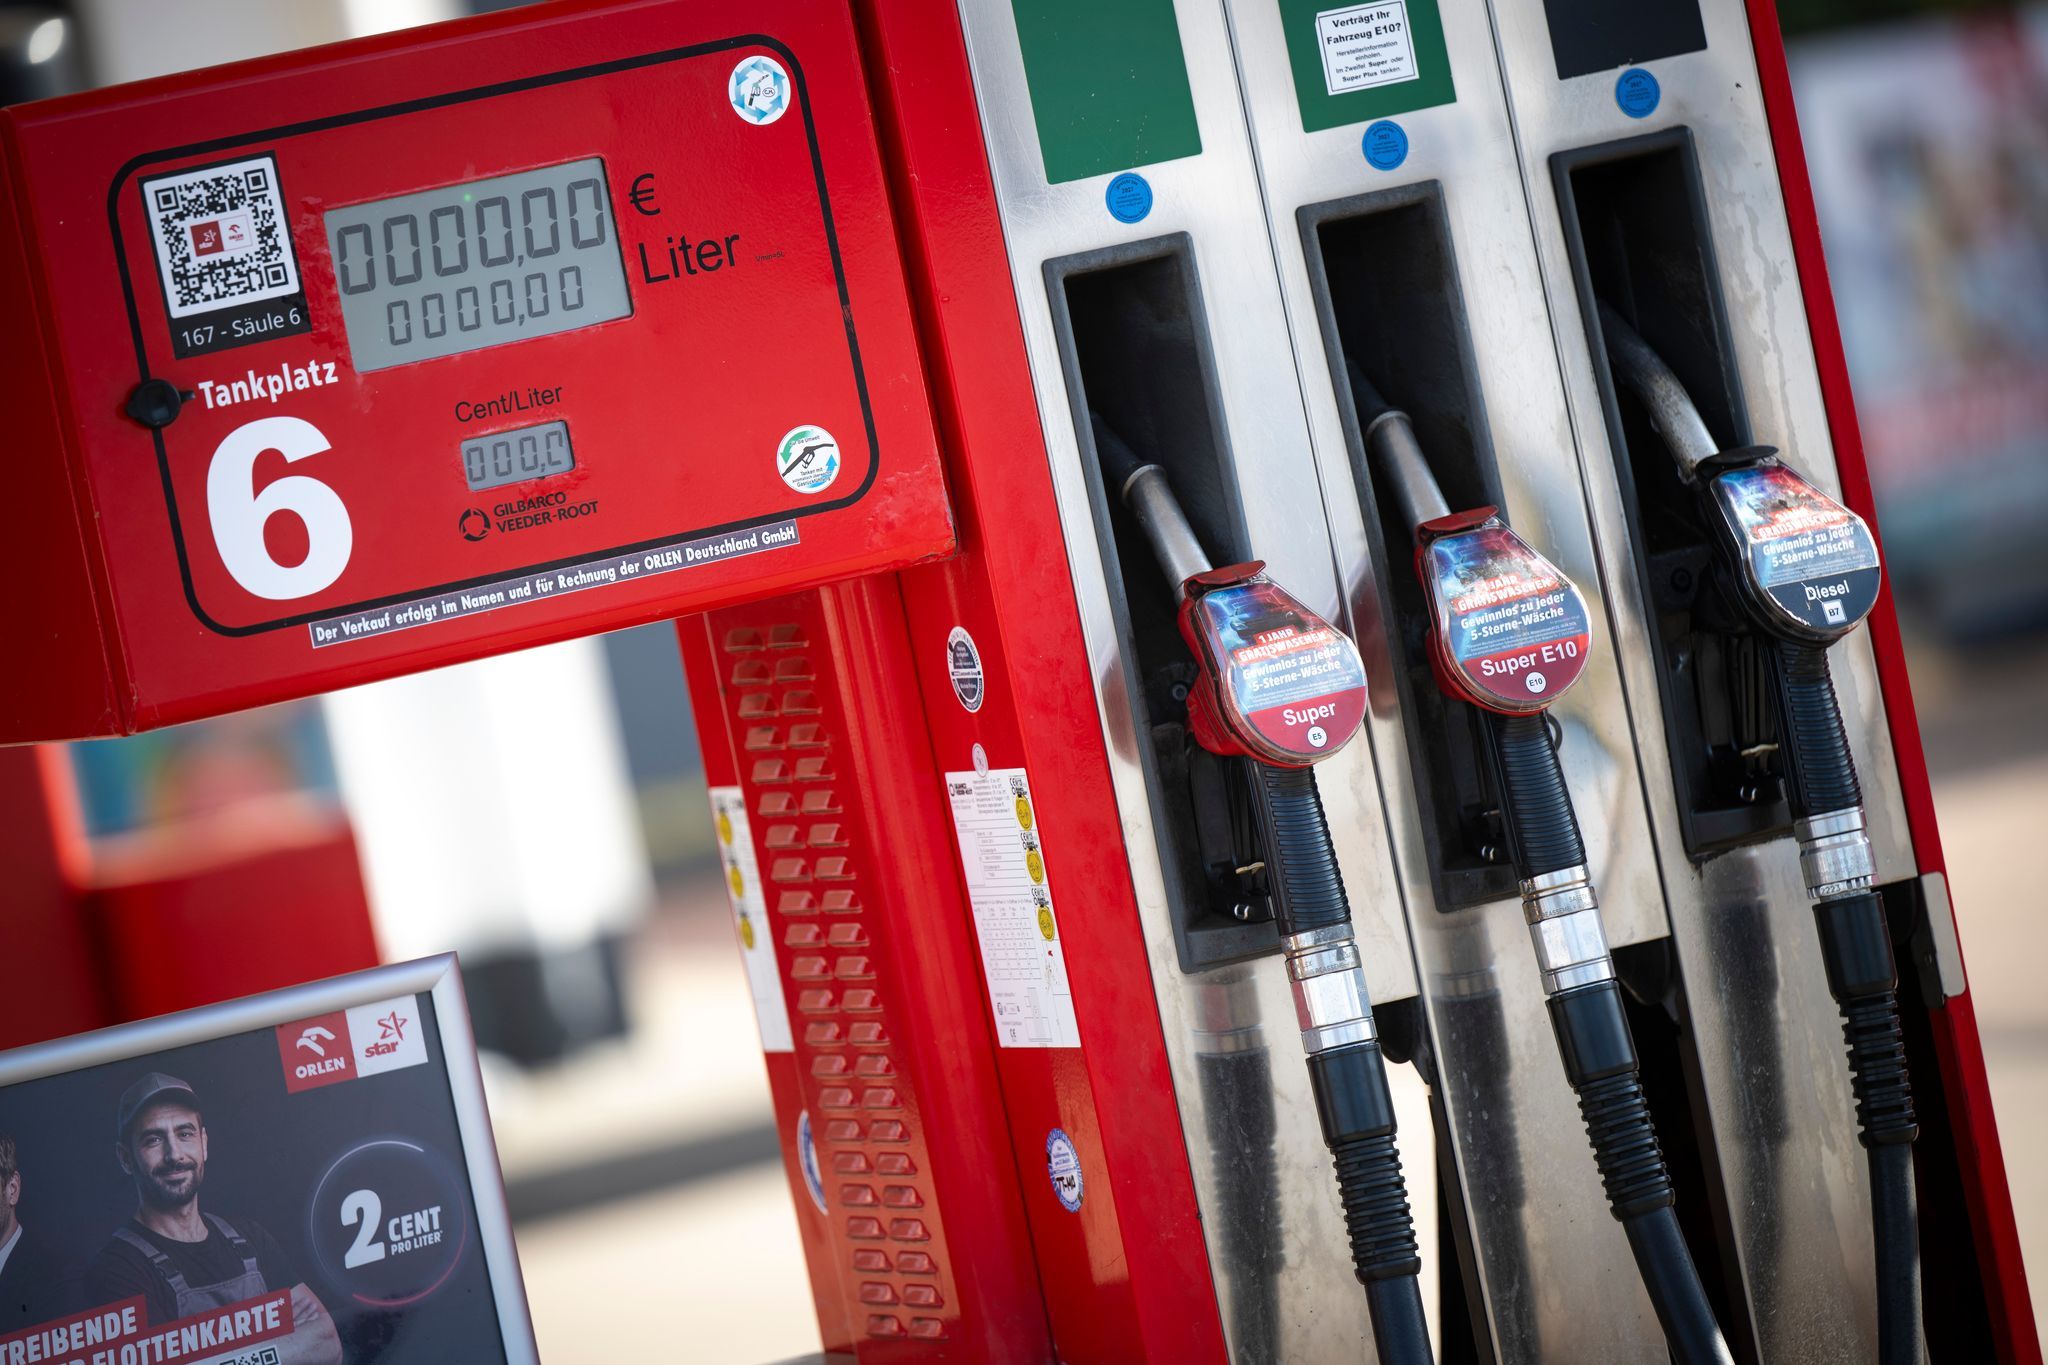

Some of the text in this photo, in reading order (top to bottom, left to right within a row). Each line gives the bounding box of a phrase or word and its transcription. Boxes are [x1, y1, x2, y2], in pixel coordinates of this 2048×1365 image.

[1327, 22, 1401, 45] Fahrzeug E10?
[1332, 11, 1390, 28] Verträgt Ihr
[1336, 40, 1398, 57] Herstellerinformation
[1342, 74, 1362, 83] Super
[1363, 71, 1378, 79] Plus
[1345, 63, 1366, 73] Zweifel
[1368, 59, 1388, 69] Super
[628, 173, 661, 216] €
[337, 178, 605, 295] 0000,00
[638, 233, 740, 284] Liter
[387, 265, 584, 346] 0000,00
[182, 326, 215, 348] 167
[232, 313, 285, 338] Säule
[289, 307, 300, 325] 6
[198, 359, 339, 409] Tankplatz
[455, 386, 562, 423] Cent/Liter
[206, 415, 353, 600] 6
[493, 491, 567, 517] GILBARCO
[496, 501, 599, 533] VEEDER-ROOT
[1762, 525, 1855, 556] Gewinnlos zu jeder
[1771, 539, 1855, 568] 5-Sterne-Wäsche
[315, 525, 796, 642] Der Verkauf erfolgt im Namen und für Rechnung der ORLEN Deutschland GmbH
[1805, 579, 1850, 601] Diesel
[1460, 592, 1565, 629] Gewinnlos zu jeder
[1471, 606, 1564, 641] 5-Sterne-Wäsche
[1828, 607, 1840, 617] B7
[1258, 628, 1295, 644] 1 JAHR
[1243, 645, 1341, 681] Gewinnlos zu jeder
[1480, 640, 1577, 677] Super E10
[1252, 659, 1341, 692] 5-Sterne-Wäsche
[1529, 678, 1543, 687] E10
[1283, 702, 1336, 726] Super
[1312, 732, 1322, 741] E5
[365, 1041, 398, 1058] star
[295, 1056, 346, 1079] ORLEN
[340, 1189, 385, 1269] 2
[388, 1205, 441, 1242] CENT
[391, 1240, 412, 1255] PRO
